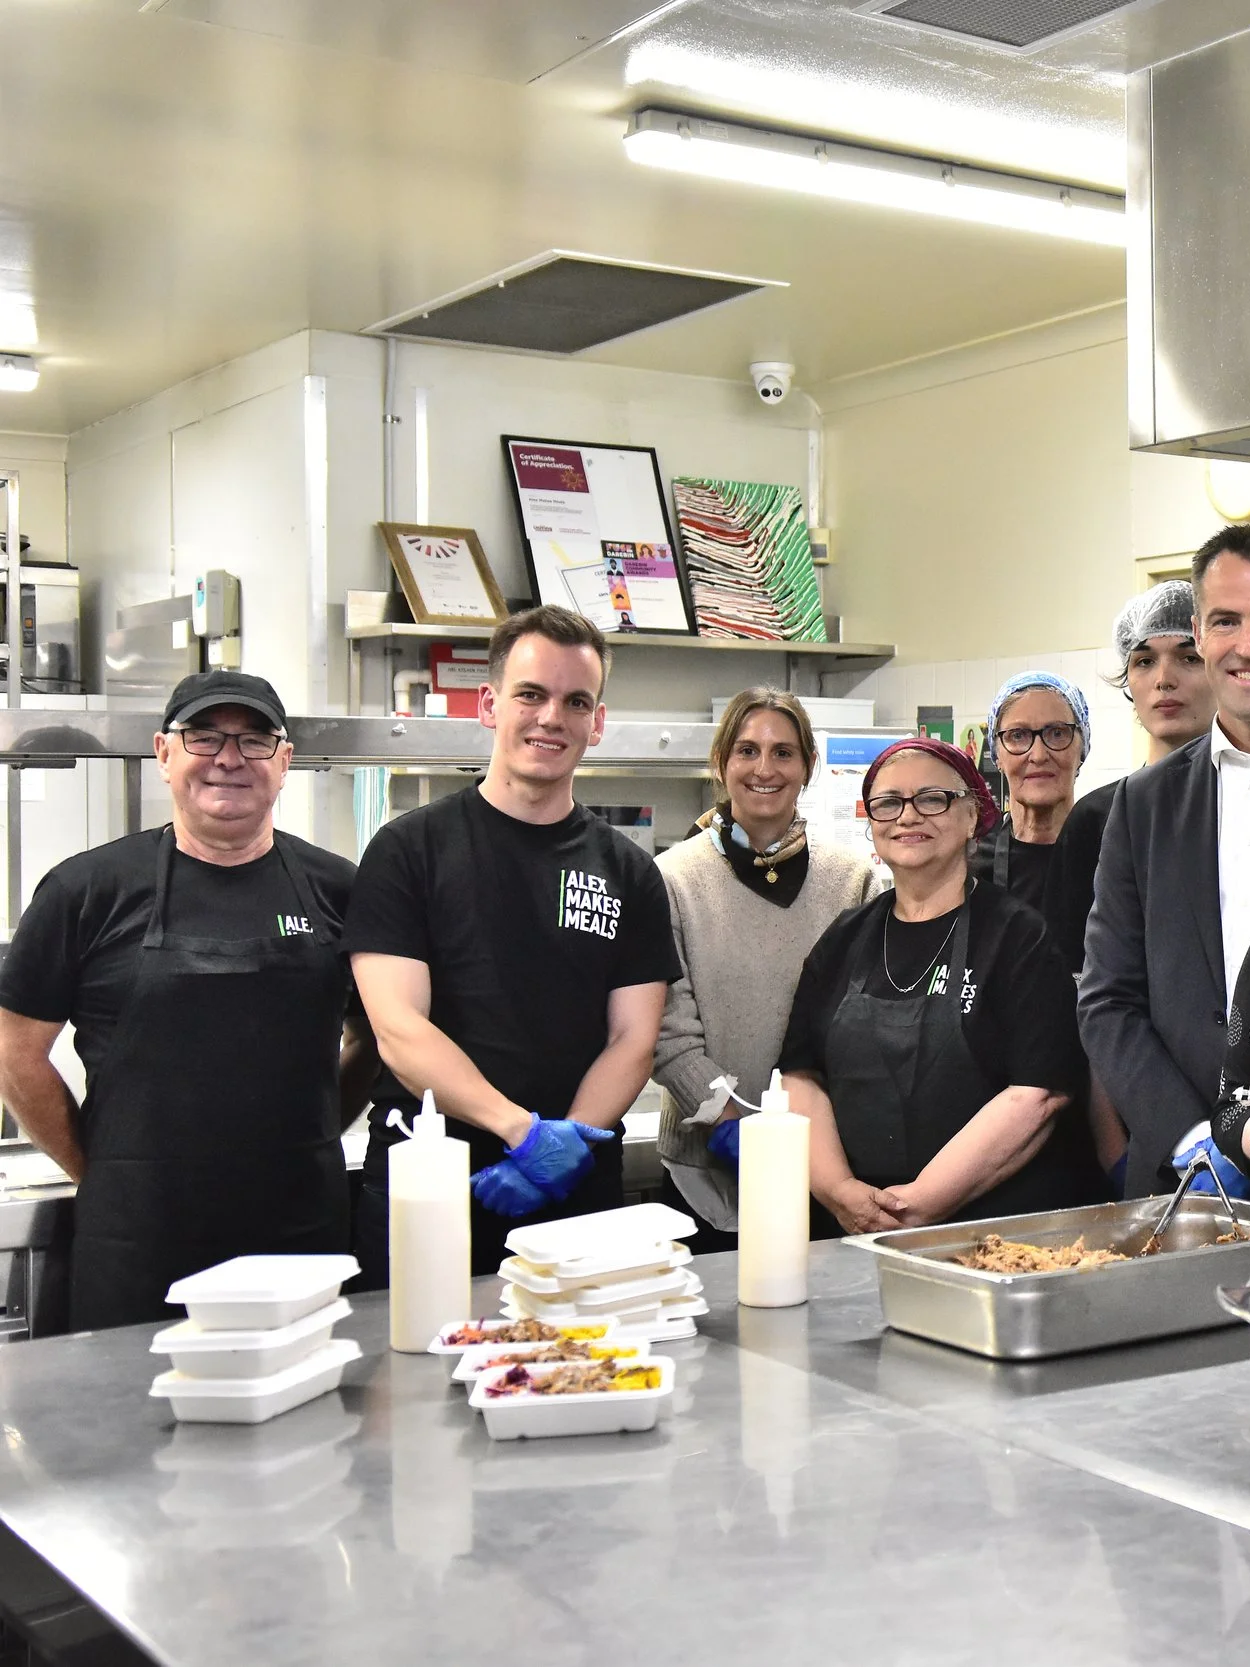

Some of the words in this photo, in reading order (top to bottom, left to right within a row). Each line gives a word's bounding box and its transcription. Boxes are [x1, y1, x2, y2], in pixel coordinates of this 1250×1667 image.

[519, 453, 555, 462] Certificate
[566, 869, 608, 895] ALEX
[565, 888, 622, 919] MAKES
[285, 915, 314, 933] ALE
[564, 908, 618, 940] MEALS
[936, 964, 973, 983] AX
[931, 979, 977, 999] MES
